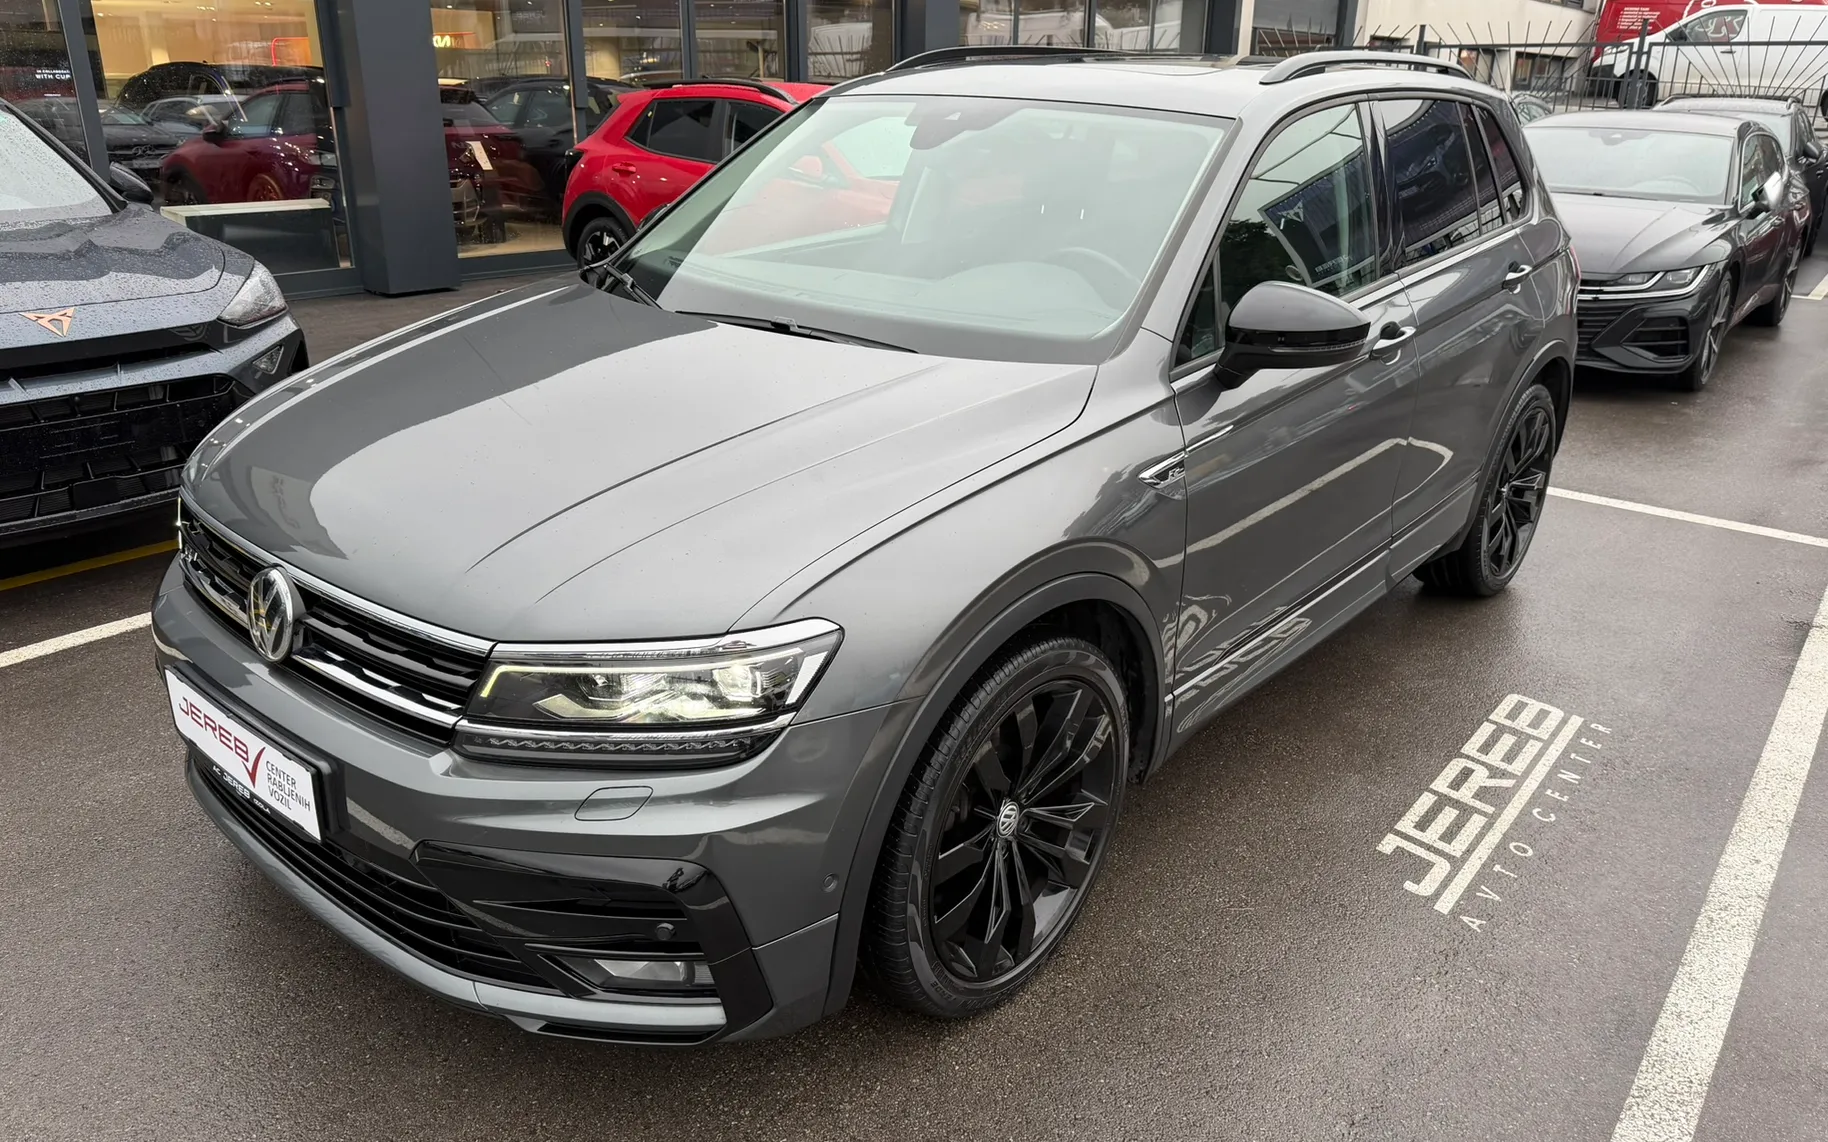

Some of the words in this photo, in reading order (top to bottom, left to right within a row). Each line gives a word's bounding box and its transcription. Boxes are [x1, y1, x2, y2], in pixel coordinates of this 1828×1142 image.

[179, 696, 250, 763] JEREB
[222, 772, 251, 799] JEREB
[265, 760, 297, 790] CENTER
[267, 772, 311, 812] RABLJENIH
[1376, 693, 1564, 896] JEREB
[268, 785, 292, 811] VOZIL
[1459, 841, 1534, 933] AVTO
[1532, 722, 1613, 823] CENTER
